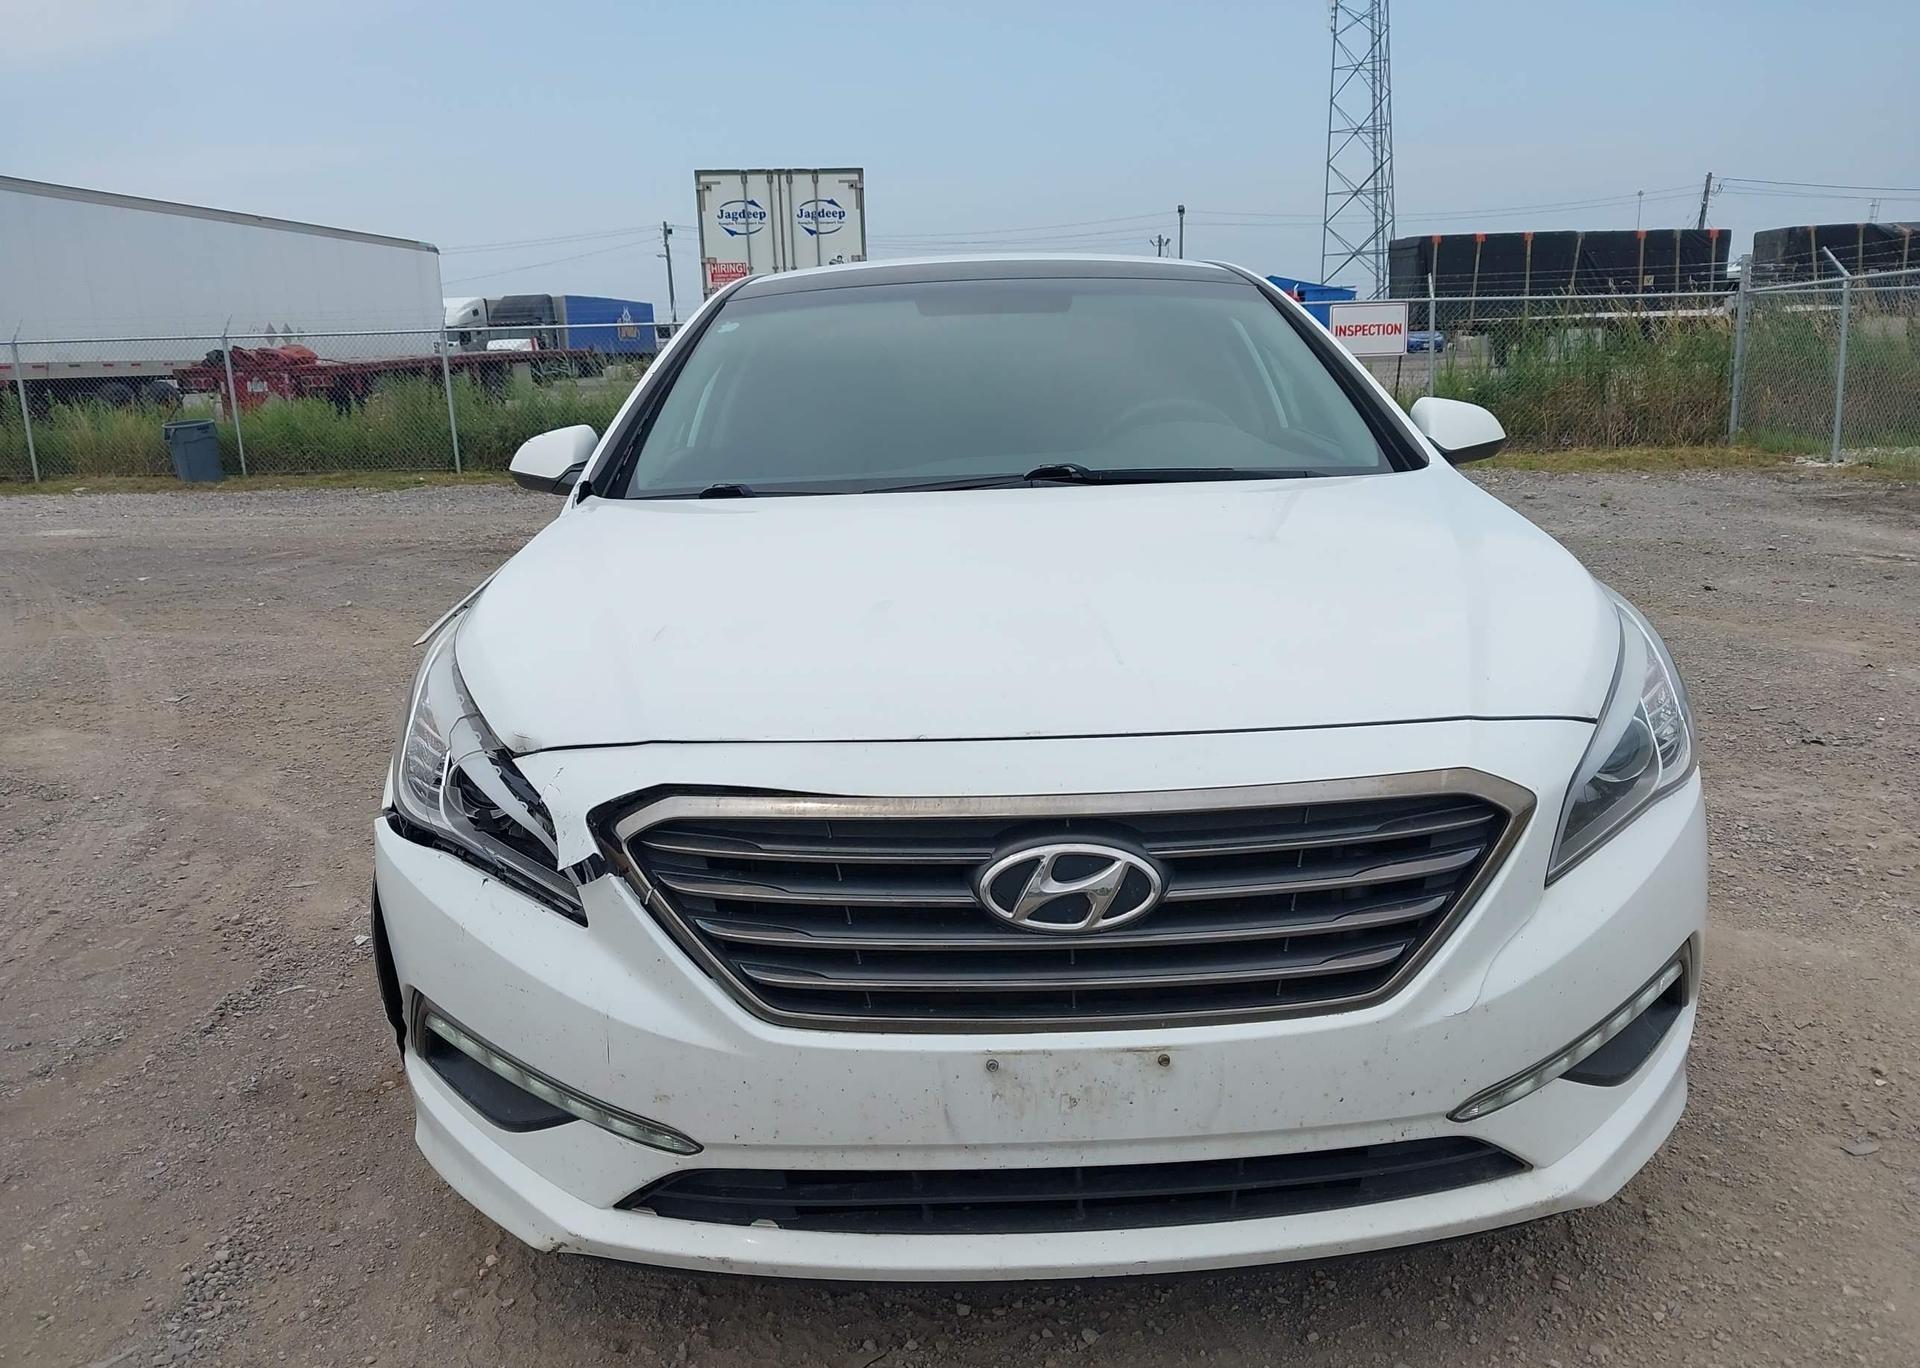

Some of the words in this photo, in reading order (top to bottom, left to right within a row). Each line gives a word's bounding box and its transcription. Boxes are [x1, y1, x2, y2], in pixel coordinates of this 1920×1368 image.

[717, 209, 766, 221] Jagdeep
[796, 208, 846, 220] Jagdeep
[711, 263, 746, 273] HIRING!
[1335, 323, 1402, 337] INSPECTION
